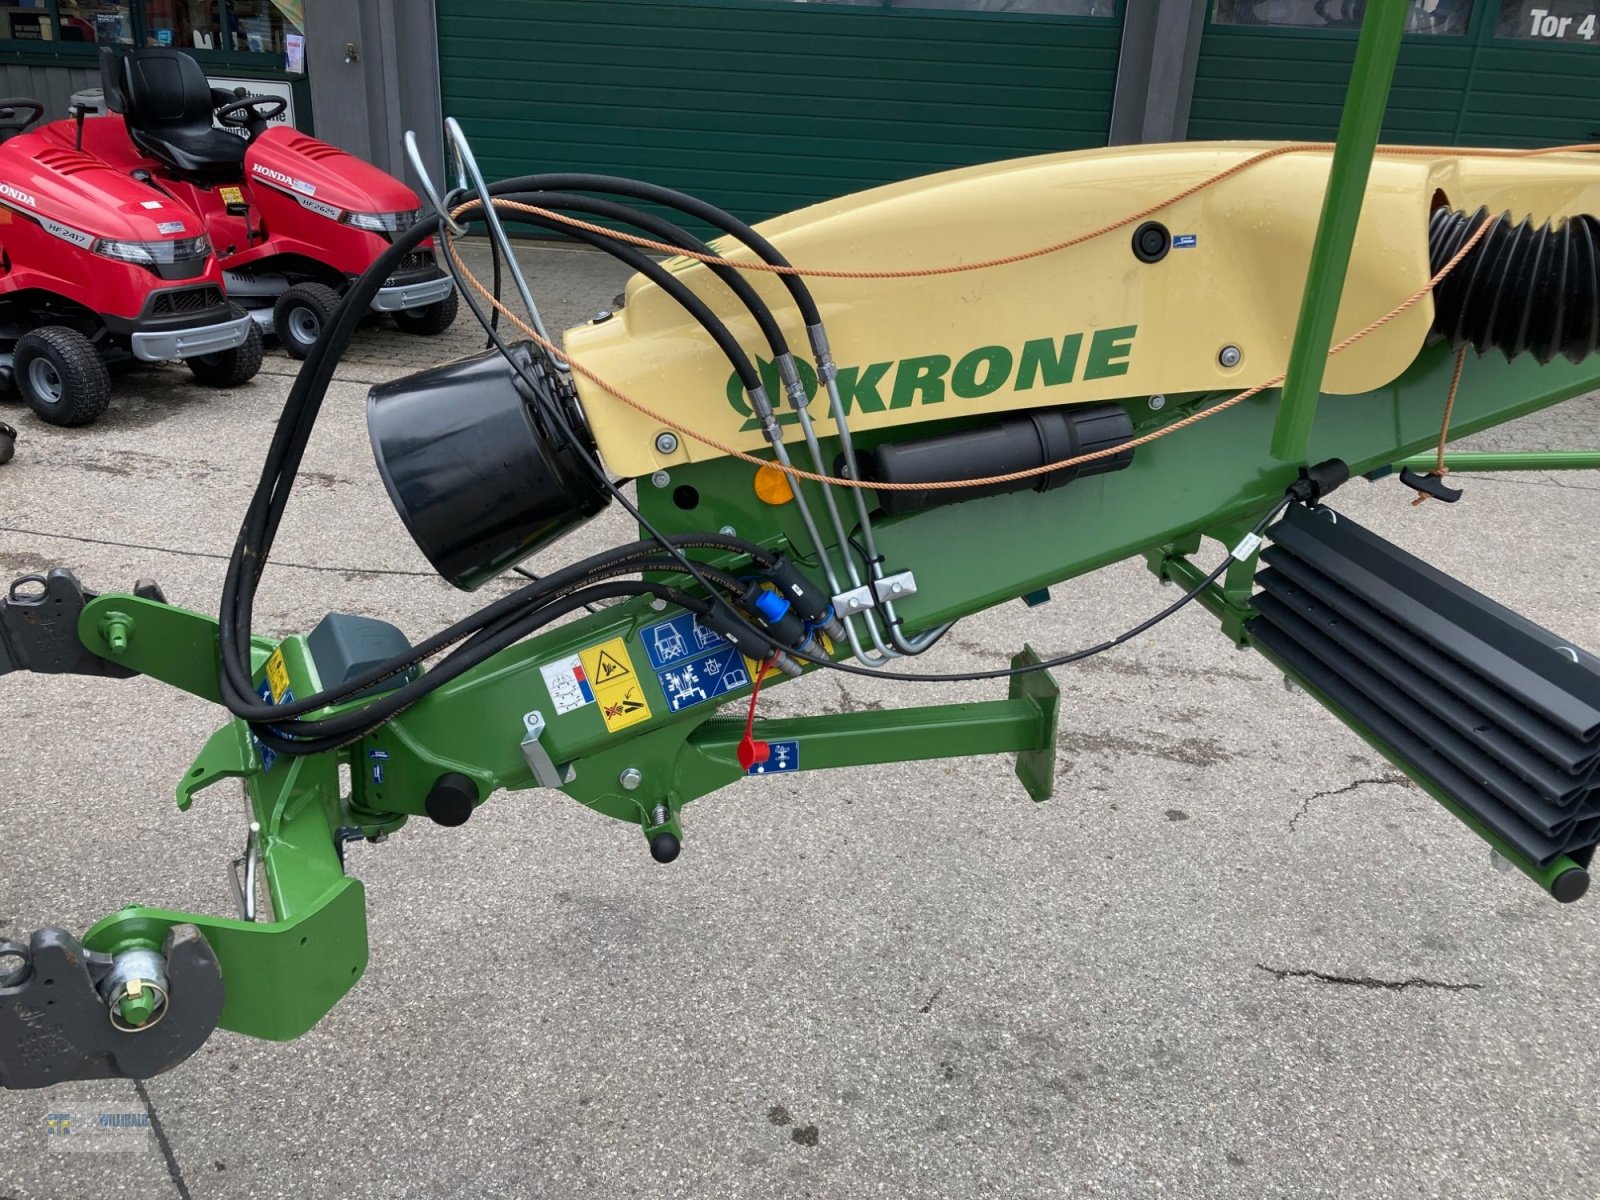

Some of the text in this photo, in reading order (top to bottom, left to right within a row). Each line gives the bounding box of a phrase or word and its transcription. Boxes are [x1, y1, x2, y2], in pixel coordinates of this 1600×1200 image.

[1530, 8, 1596, 40] Tor 4
[252, 163, 294, 186] HONDA
[0, 182, 37, 208] ONDA
[827, 324, 1138, 419] KRONE
